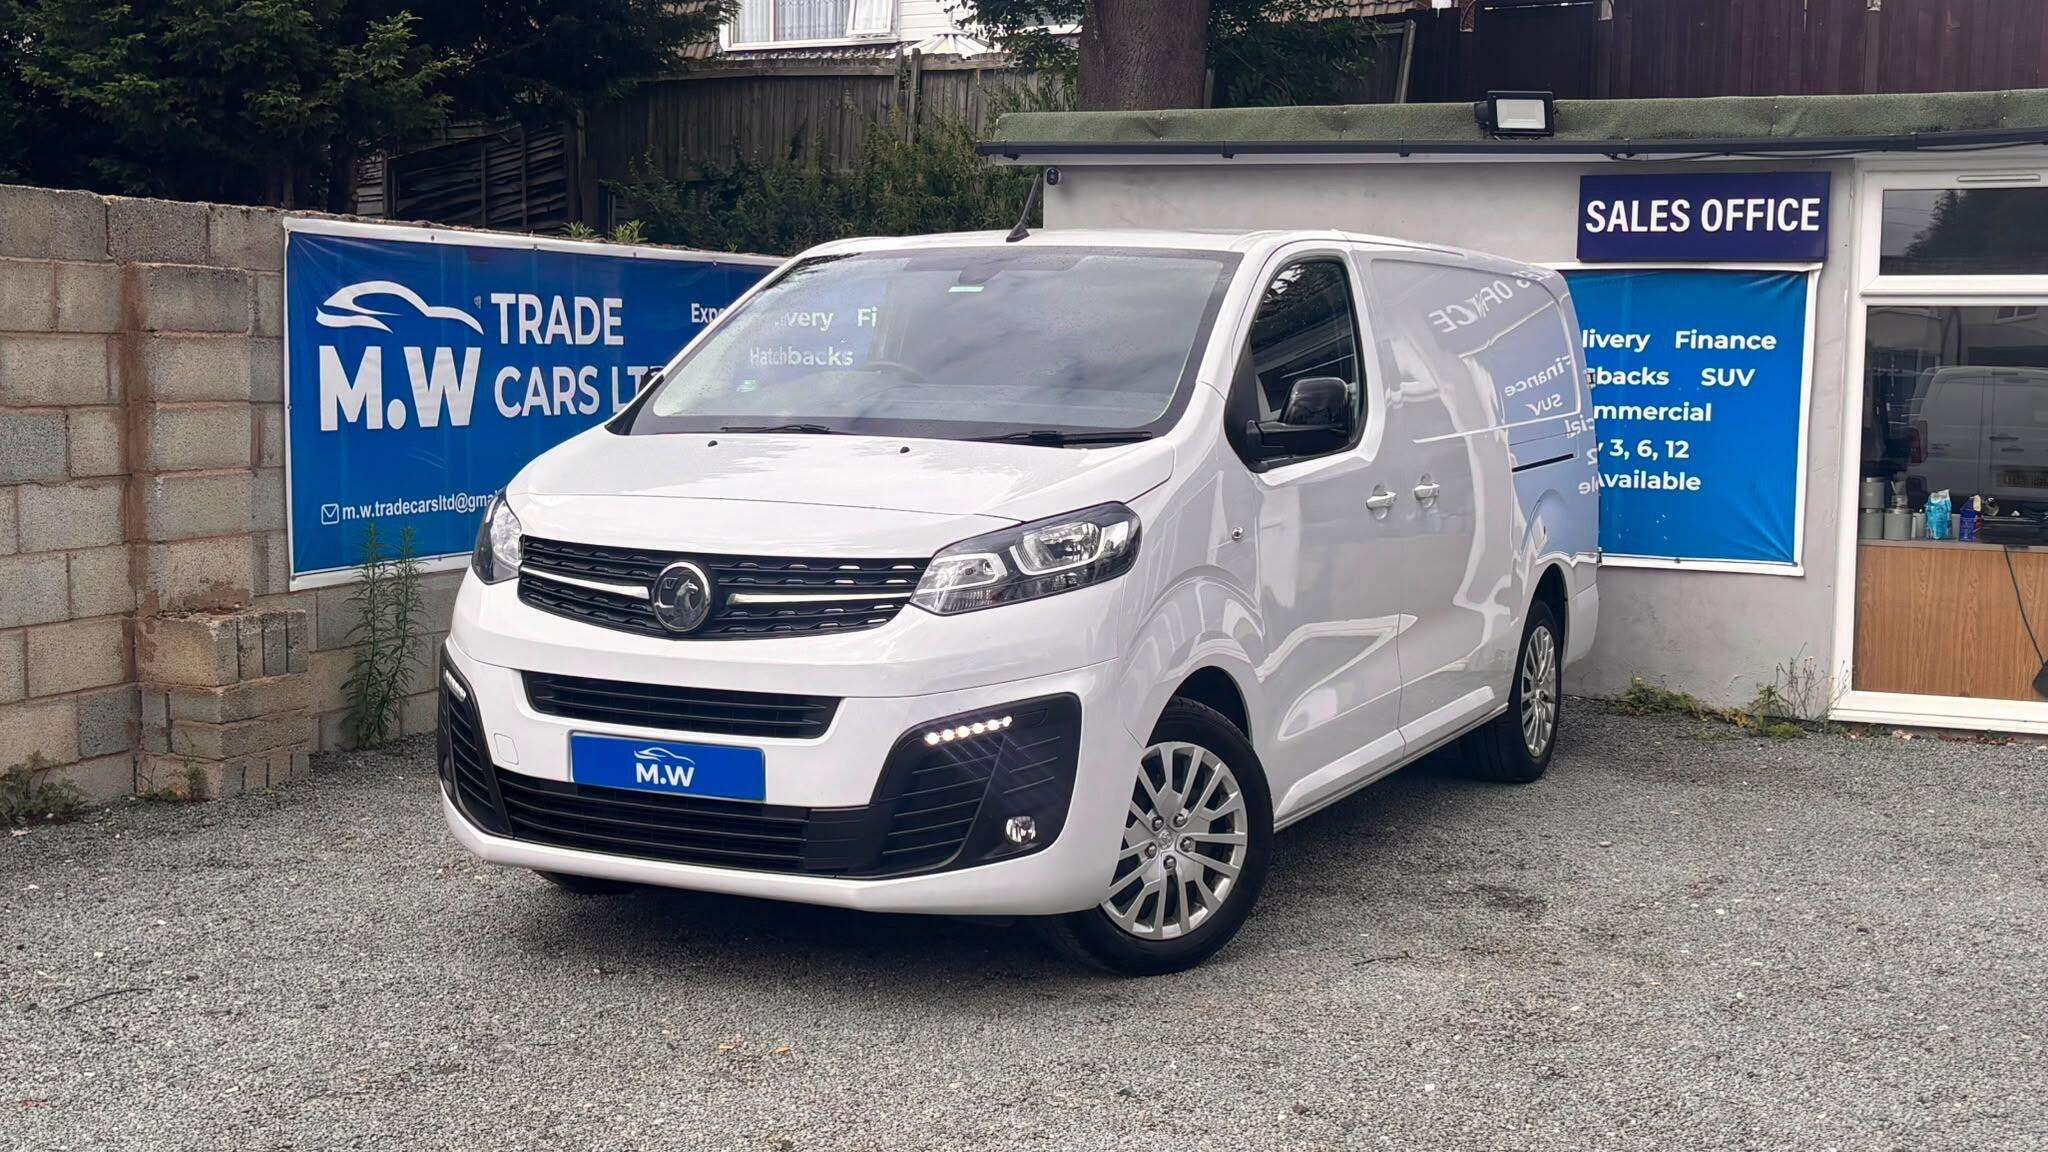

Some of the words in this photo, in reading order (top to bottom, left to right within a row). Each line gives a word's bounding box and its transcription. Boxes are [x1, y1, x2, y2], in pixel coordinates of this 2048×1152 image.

[1585, 199, 1691, 234] SALES
[1701, 197, 1821, 232] OFFICE
[490, 293, 625, 346] TRADE
[691, 303, 724, 323] Exp
[1675, 329, 1778, 350] Finance
[318, 345, 482, 433] M.W
[1588, 366, 1670, 385] backs
[1701, 367, 1756, 387] SUV
[494, 366, 600, 418] CARS
[612, 366, 664, 415] LT
[1609, 439, 1630, 461] 3,
[1637, 440, 1659, 461] 6,
[1665, 440, 1690, 459] 12
[635, 762, 695, 787] M.W
